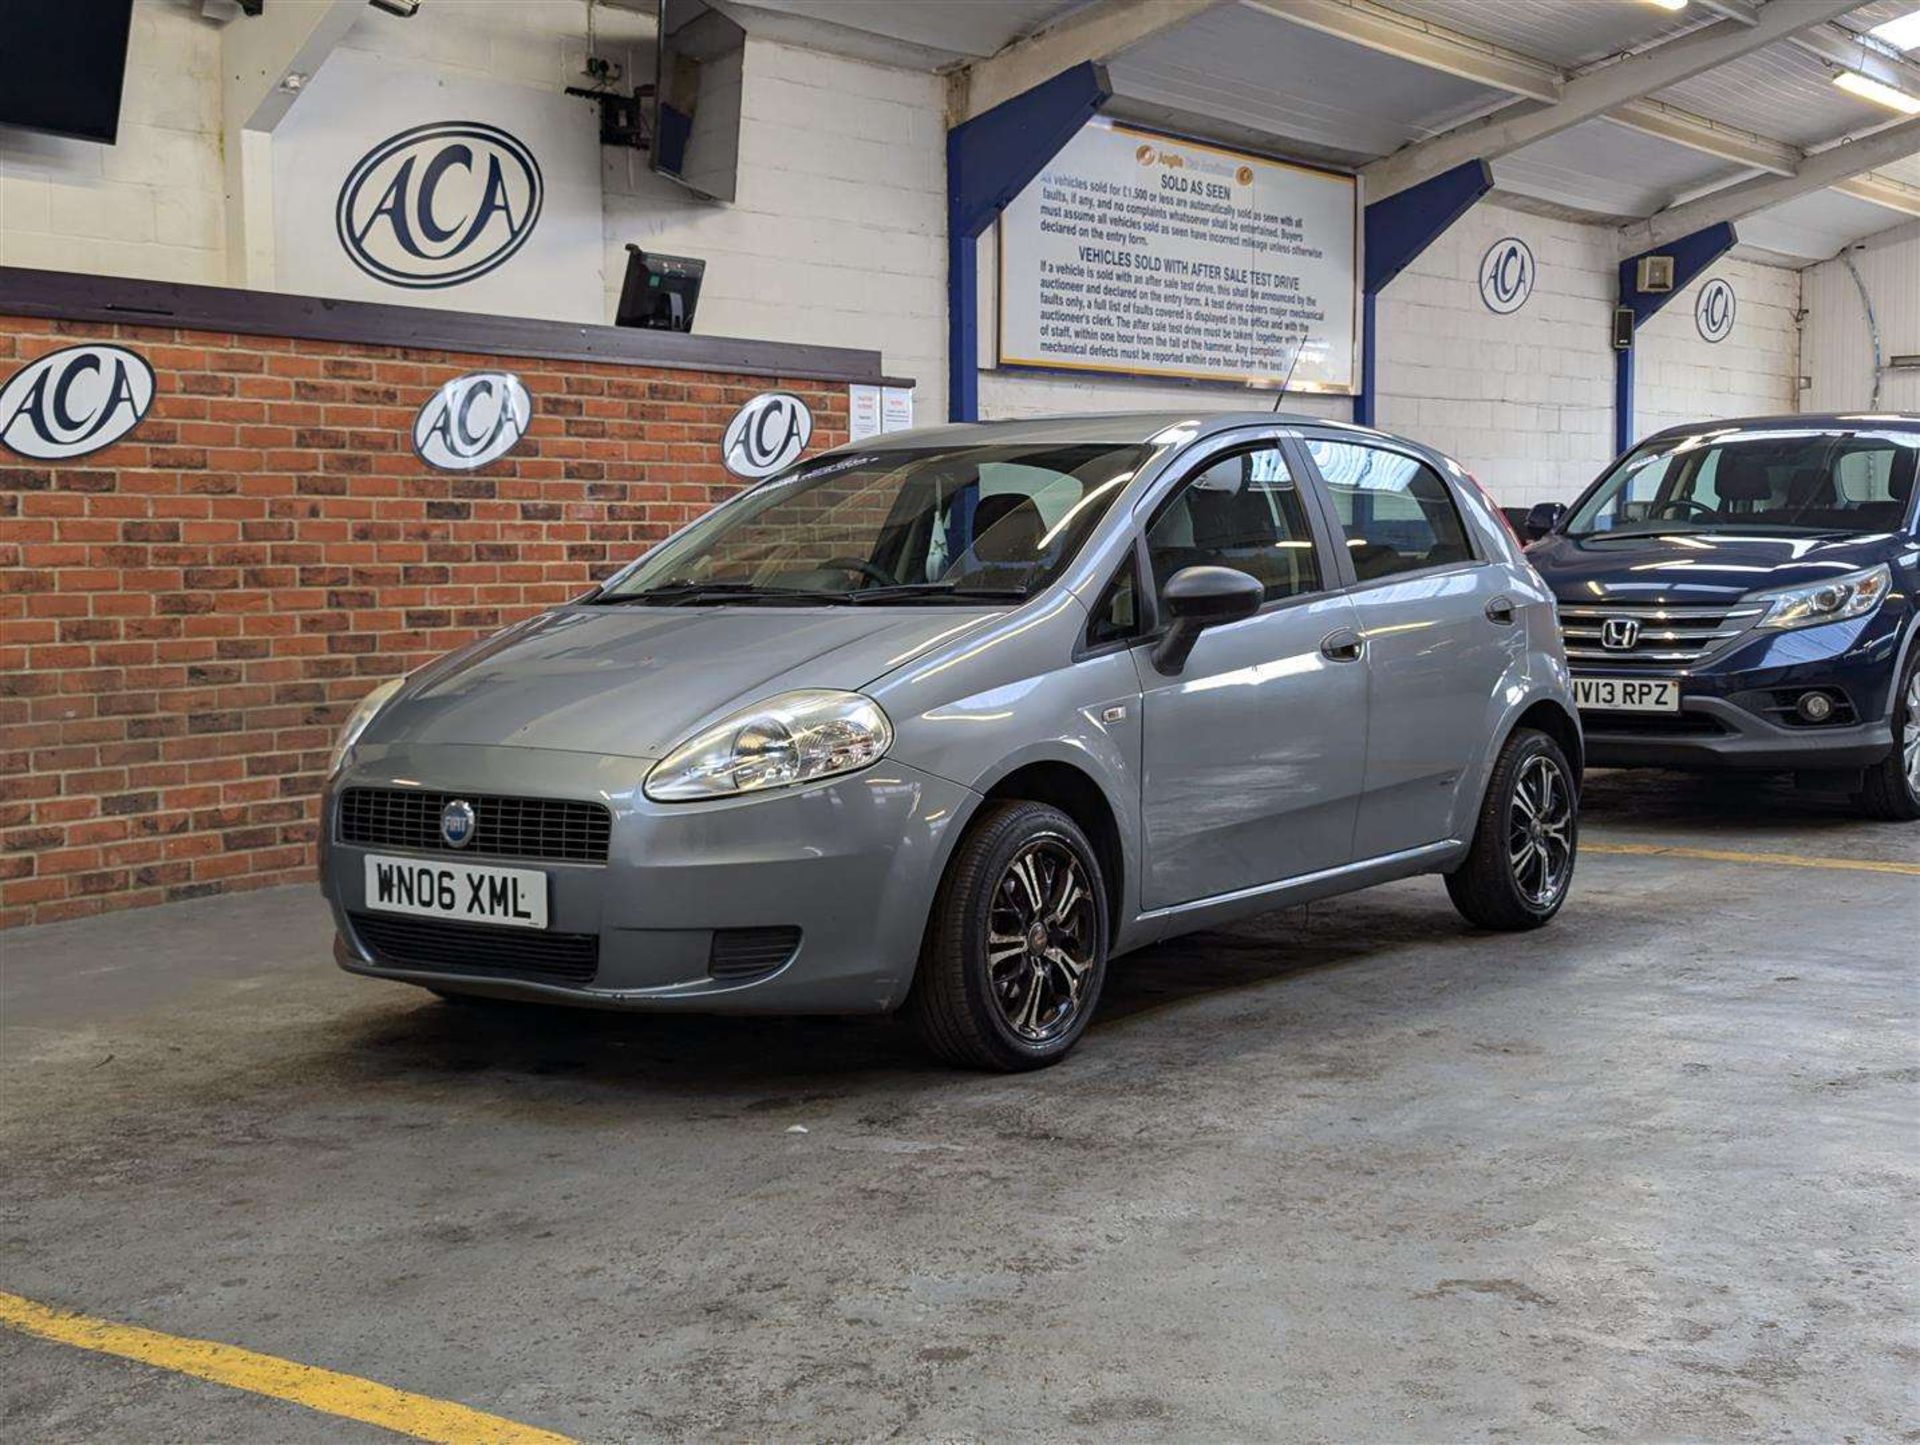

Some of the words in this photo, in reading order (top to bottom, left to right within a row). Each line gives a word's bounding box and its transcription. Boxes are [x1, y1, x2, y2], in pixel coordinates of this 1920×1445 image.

[358, 144, 518, 260] ACA
[1053, 174, 1087, 190] vehicles
[1089, 181, 1107, 193] sold
[1149, 193, 1156, 202] or
[1158, 192, 1174, 205] less
[1175, 198, 1187, 208] are
[1236, 208, 1251, 219] sold
[1253, 212, 1261, 221] as
[1262, 214, 1278, 224] seen
[1294, 218, 1302, 229] all
[1160, 173, 1187, 193] SOLD
[1190, 179, 1203, 196] AS
[1205, 182, 1230, 201] SEEN
[1039, 218, 1076, 235] declared
[1078, 226, 1088, 237] on
[1091, 226, 1103, 239] the
[1106, 230, 1126, 244] entry
[1039, 205, 1061, 217] must
[1063, 209, 1095, 223] assume
[1097, 213, 1107, 224] all
[1109, 216, 1141, 230] vehicles
[1143, 221, 1159, 233] sold
[1161, 225, 1169, 235] as
[1171, 227, 1188, 238] seen
[1190, 228, 1207, 241] have
[1208, 231, 1239, 246] incorrect
[1241, 237, 1267, 251] mileage
[1269, 242, 1290, 254] unless
[1291, 245, 1322, 259] otherwise
[1070, 192, 1076, 203] if
[1096, 198, 1112, 209] and
[1114, 202, 1124, 212] no
[1126, 204, 1167, 219] complaints
[1168, 210, 1209, 226] whatsoever
[1211, 217, 1227, 229] shall
[1229, 220, 1238, 231] be
[1280, 229, 1303, 242] Buyers
[1039, 260, 1046, 272] If
[1048, 264, 1053, 273] a
[1055, 264, 1084, 277] vehicle
[1086, 267, 1094, 278] is
[1096, 269, 1113, 281] sold
[1145, 275, 1161, 287] after
[1163, 278, 1178, 289] sale
[1180, 279, 1194, 291] test
[1232, 287, 1248, 298] shall
[1250, 289, 1258, 300] be
[1260, 292, 1295, 304] announced
[1306, 296, 1316, 307] the
[1078, 245, 1131, 267] VEHICLES
[1134, 254, 1161, 271] SOLD
[1163, 258, 1188, 275] WITH
[1191, 262, 1221, 280] AFTER
[1223, 267, 1247, 283] SALE
[1250, 270, 1271, 287] TEST
[1273, 274, 1299, 290] DRIVE
[1483, 246, 1527, 303] ACA
[1039, 278, 1083, 292] auctioneer
[1085, 283, 1100, 295] and
[1102, 284, 1137, 299] declared
[1139, 291, 1148, 300] on
[1150, 290, 1161, 302] the
[1163, 293, 1181, 306] entry
[1210, 298, 1224, 309] test
[1226, 300, 1243, 312] drive
[1245, 304, 1267, 314] covers
[1269, 307, 1287, 318] major
[1288, 309, 1323, 321] mechanical
[1039, 292, 1063, 306] faults
[1086, 299, 1091, 309] a
[1093, 298, 1106, 311] full
[1108, 300, 1120, 312] list
[1123, 302, 1130, 313] of
[1132, 302, 1153, 316] faults
[1155, 307, 1184, 319] covered
[1185, 309, 1192, 320] is
[1194, 310, 1227, 325] displayed
[1237, 315, 1248, 326] the
[1250, 317, 1269, 328] office
[1270, 319, 1282, 330] and
[1299, 322, 1308, 333] the
[1039, 324, 1048, 336] of
[1073, 328, 1098, 340] within
[1100, 332, 1114, 342] one
[1116, 331, 1134, 344] hour
[1136, 333, 1153, 345] from
[1155, 335, 1167, 347] the
[1168, 337, 1180, 348] fall
[1181, 338, 1189, 349] of
[1190, 339, 1202, 350] the
[1235, 343, 1248, 356] Any
[1116, 316, 1130, 328] The
[1132, 318, 1149, 330] after
[1151, 321, 1166, 332] sale
[1168, 322, 1182, 333] test
[1184, 323, 1201, 335] drive
[1203, 327, 1220, 337] must
[1222, 328, 1231, 338] be
[1255, 331, 1283, 344] together
[1039, 341, 1087, 355] mechanical
[1089, 344, 1118, 357] defects
[1120, 348, 1139, 359] must
[1141, 349, 1150, 360] be
[1152, 352, 1183, 363] reported
[1185, 353, 1206, 365] within
[1208, 357, 1220, 366] one
[1222, 356, 1238, 367] hour
[1240, 358, 1256, 369] from
[1257, 359, 1267, 370] the
[0, 353, 142, 444] ACA
[420, 380, 522, 458] ACA
[726, 399, 804, 468] ACA
[1622, 683, 1669, 706] RPZ
[444, 816, 468, 833] FIAT
[377, 863, 456, 911] WN06
[466, 872, 532, 920] XML
